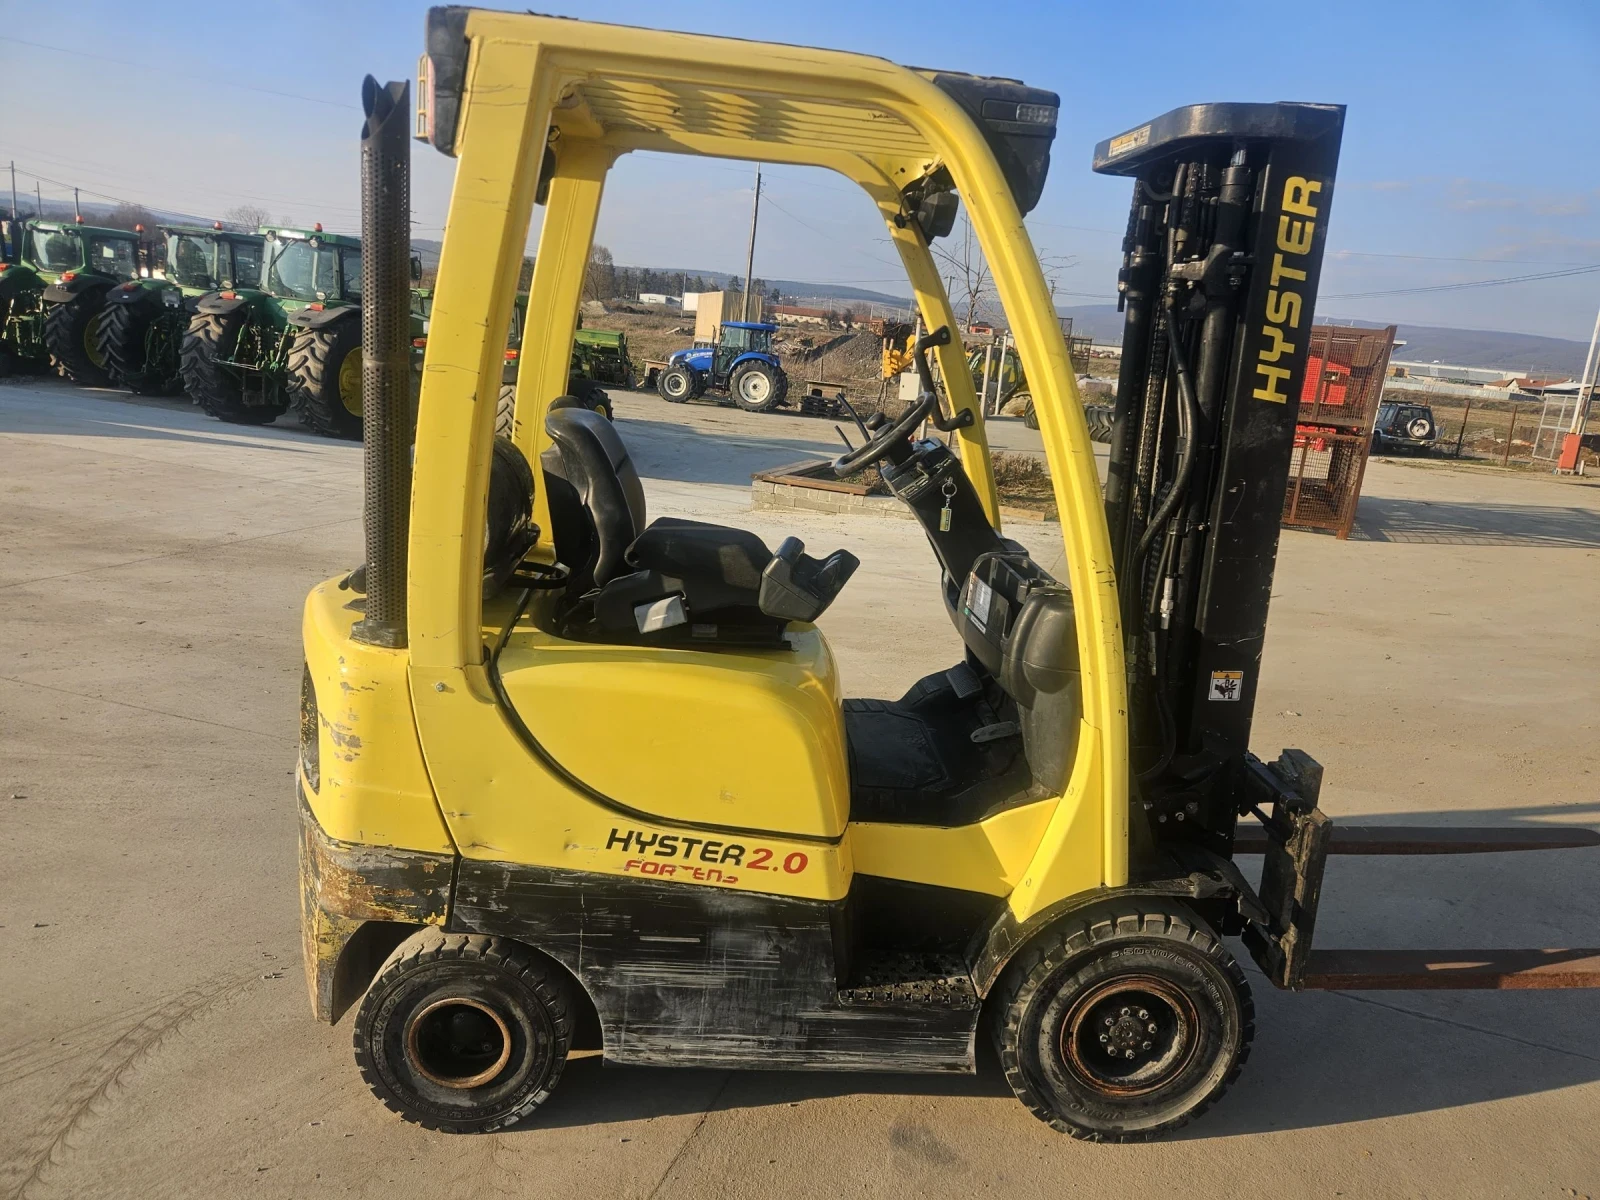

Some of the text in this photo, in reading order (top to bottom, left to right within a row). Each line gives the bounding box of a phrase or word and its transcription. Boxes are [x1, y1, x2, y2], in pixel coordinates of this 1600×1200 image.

[1252, 175, 1322, 404] HYSTER
[605, 828, 809, 874] HYSTER 2.0
